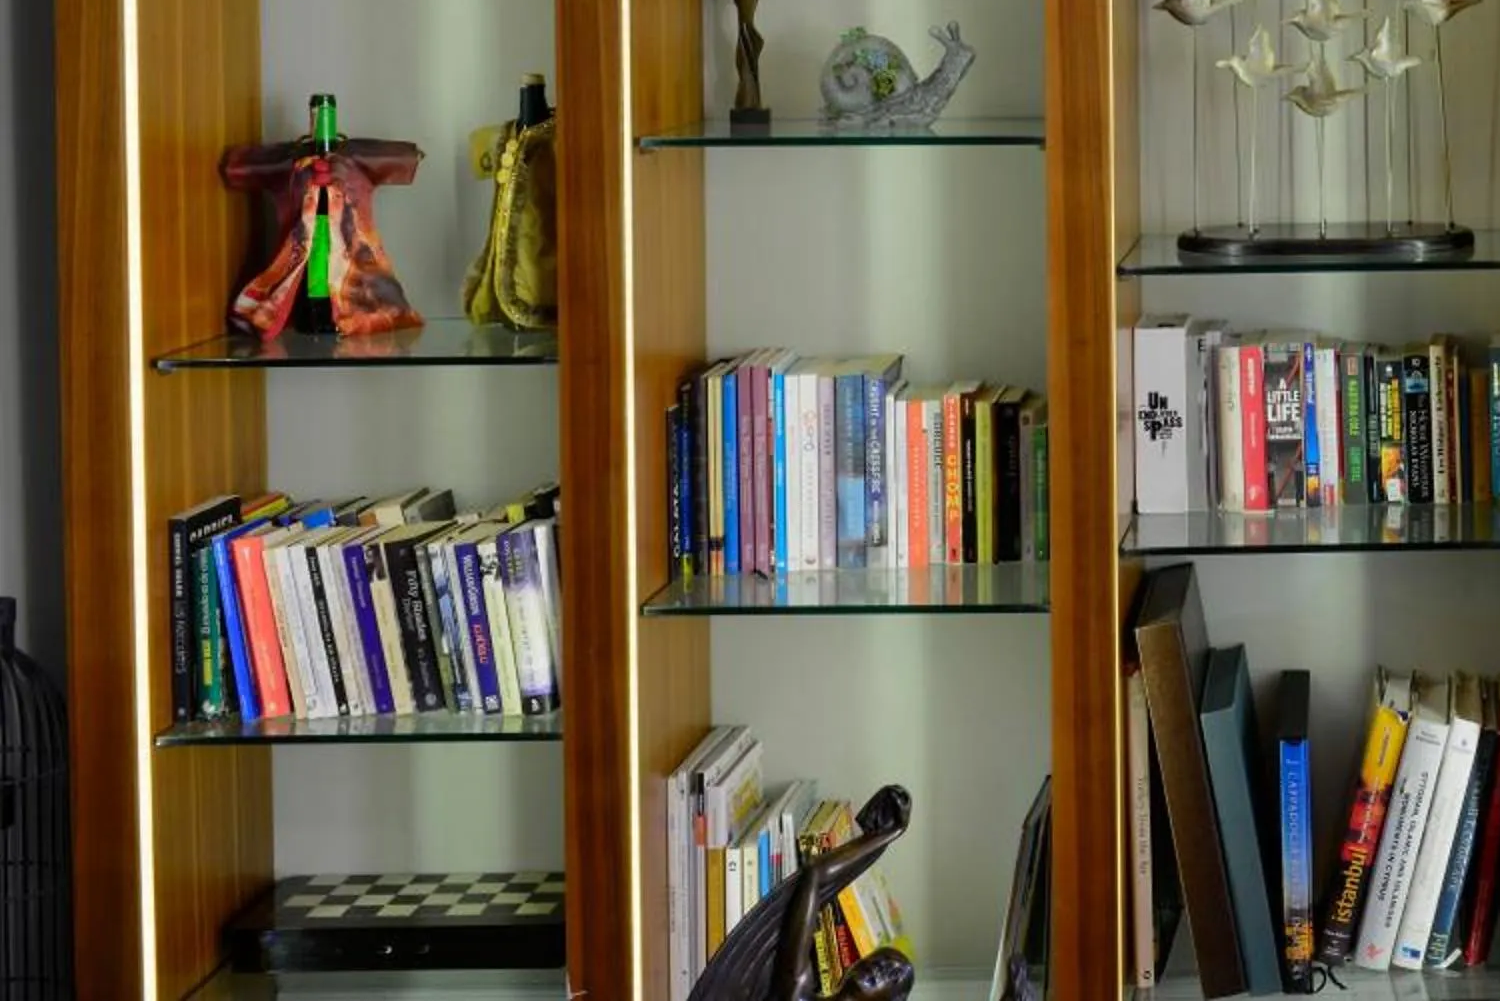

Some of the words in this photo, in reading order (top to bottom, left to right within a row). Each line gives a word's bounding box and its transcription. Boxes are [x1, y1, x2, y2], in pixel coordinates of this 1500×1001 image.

[1278, 377, 1287, 390] A
[1266, 390, 1300, 403] LITTLE
[1267, 403, 1301, 422] LIFE
[405, 569, 419, 598] Fifty
[412, 599, 428, 642] Shades
